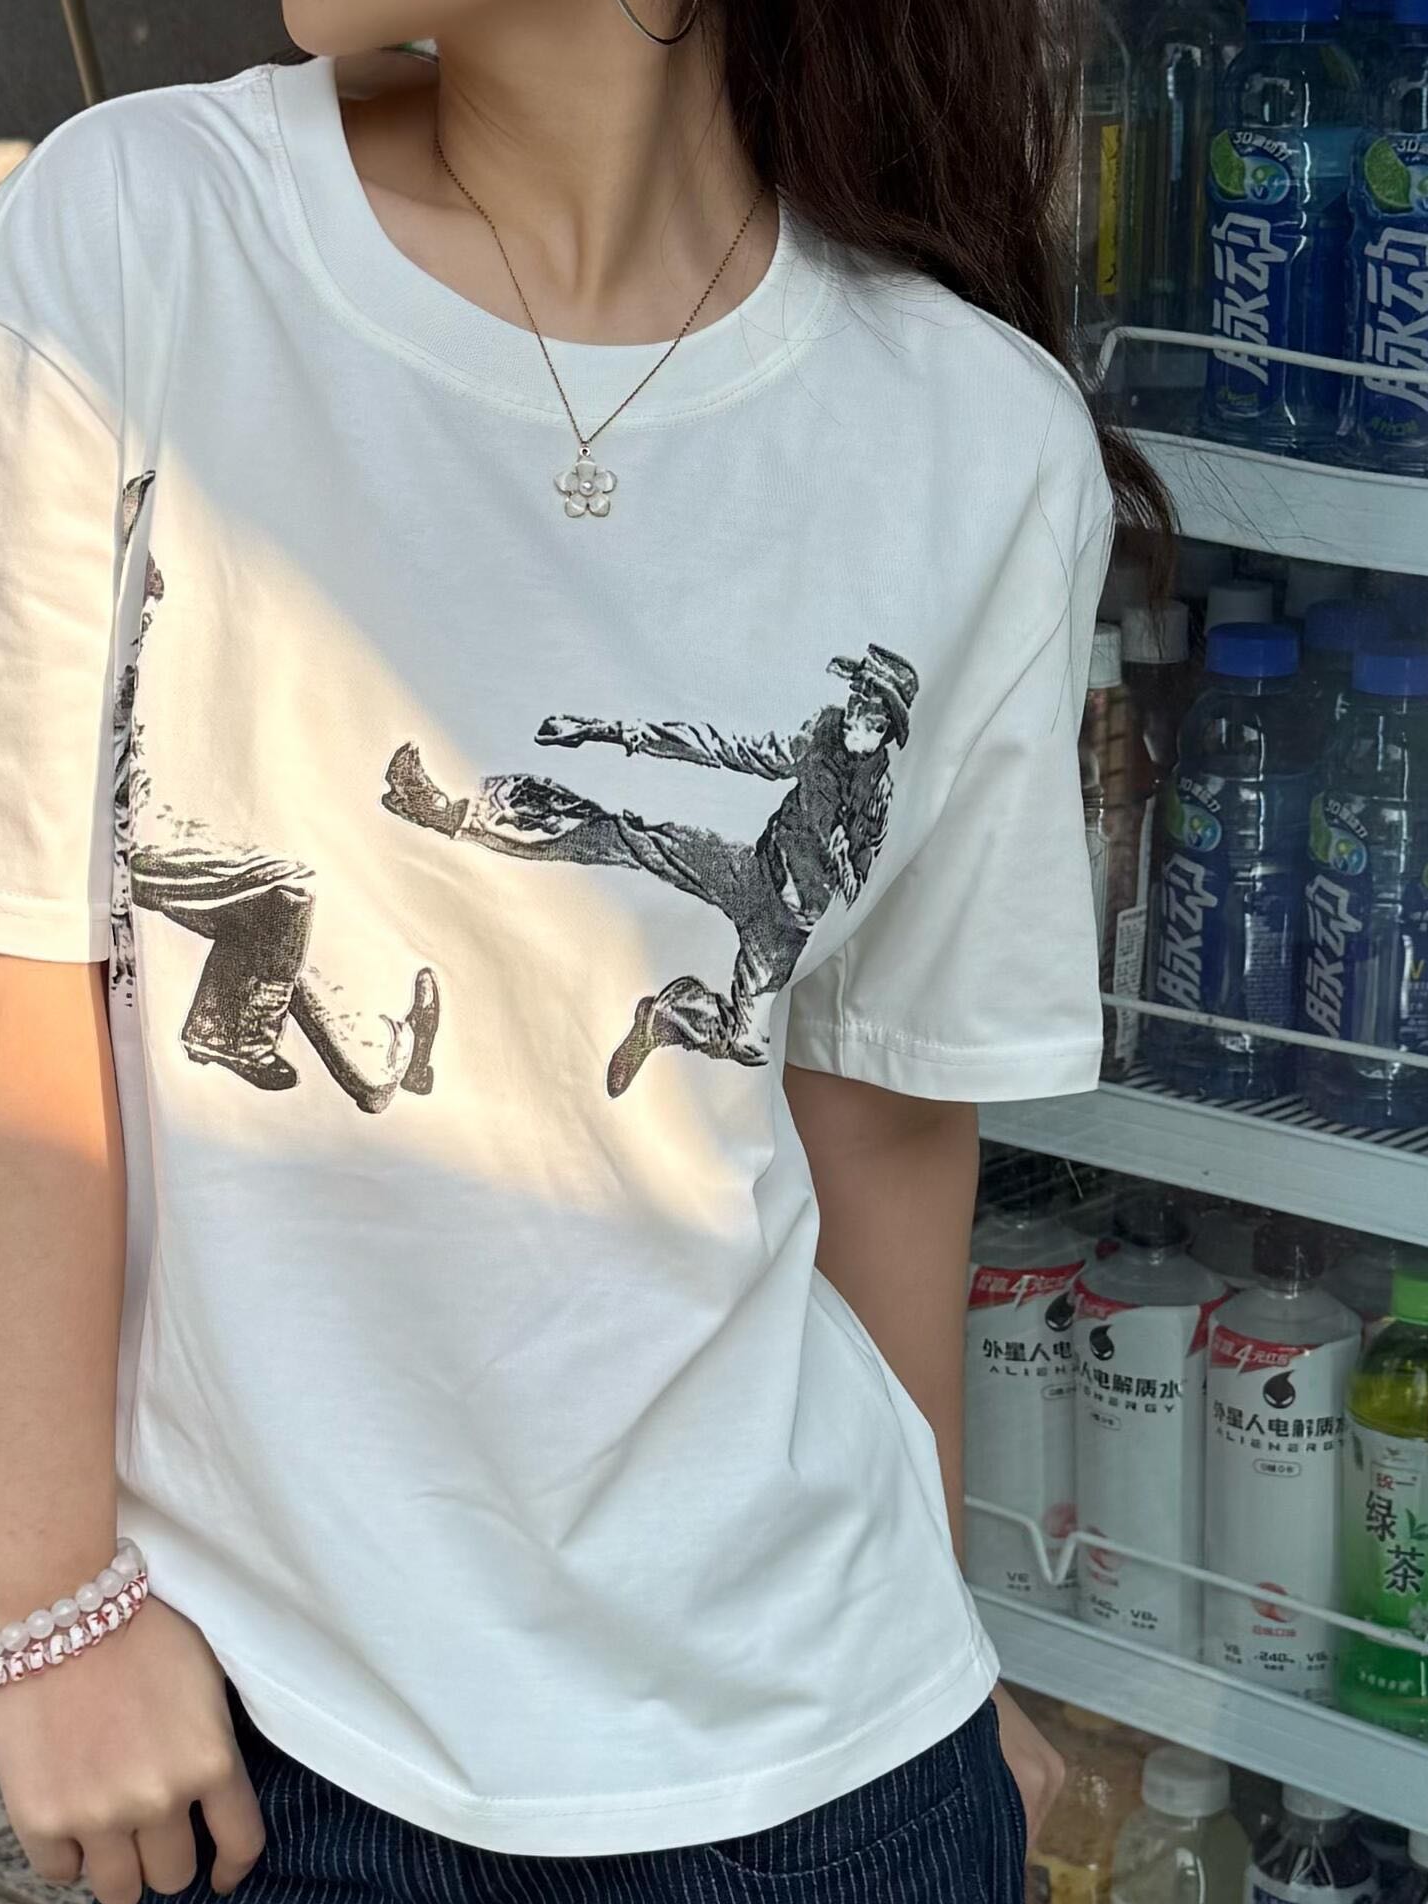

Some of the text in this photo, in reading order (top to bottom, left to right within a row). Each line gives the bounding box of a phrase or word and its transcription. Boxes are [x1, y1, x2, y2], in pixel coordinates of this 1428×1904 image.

[1213, 211, 1288, 387] 脉动
[1156, 852, 1219, 1012] 脉动
[1304, 874, 1363, 1040] 脉动
[1365, 1490, 1426, 1594] 绿茶
